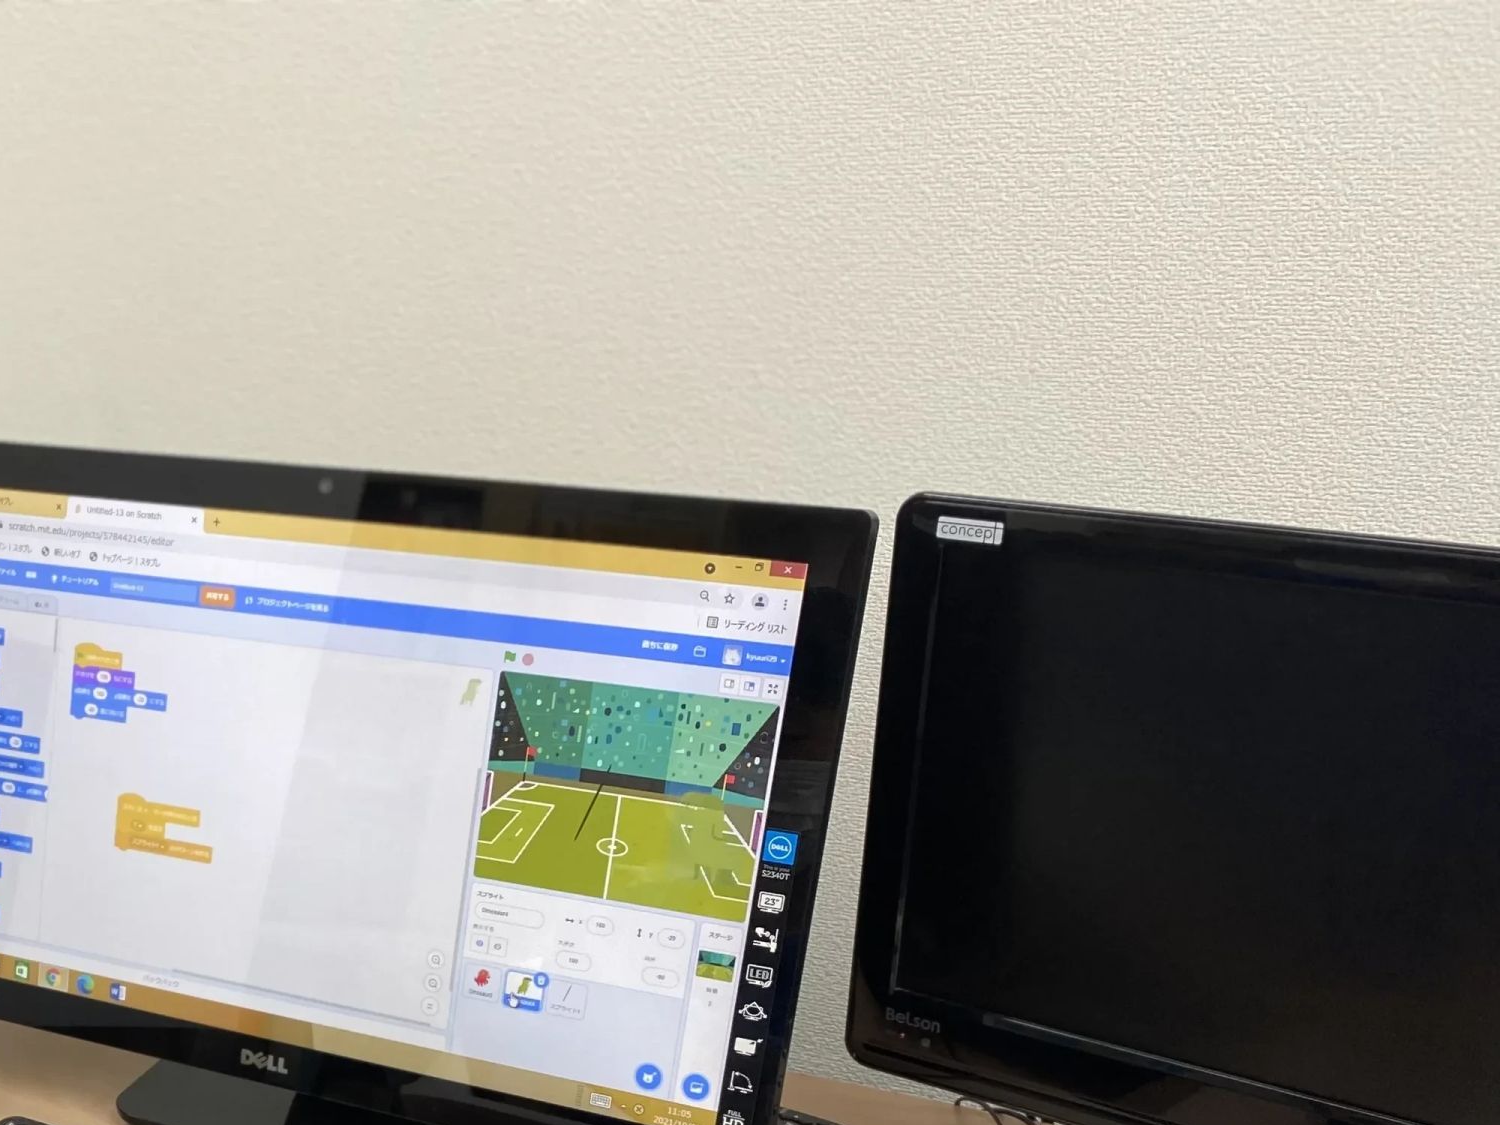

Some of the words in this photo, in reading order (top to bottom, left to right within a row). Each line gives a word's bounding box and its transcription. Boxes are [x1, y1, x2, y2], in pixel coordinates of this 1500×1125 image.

[86, 506, 125, 518] Untitled-13
[136, 511, 162, 521] Scratch
[723, 619, 766, 633] リーディング
[767, 624, 788, 635] リスト
[770, 843, 789, 852] DELL
[761, 869, 791, 880] S2340T
[749, 968, 769, 980] LED
[240, 1048, 288, 1075] DELL
[668, 1106, 692, 1118] 11:05
[727, 1109, 742, 1117] FULL
